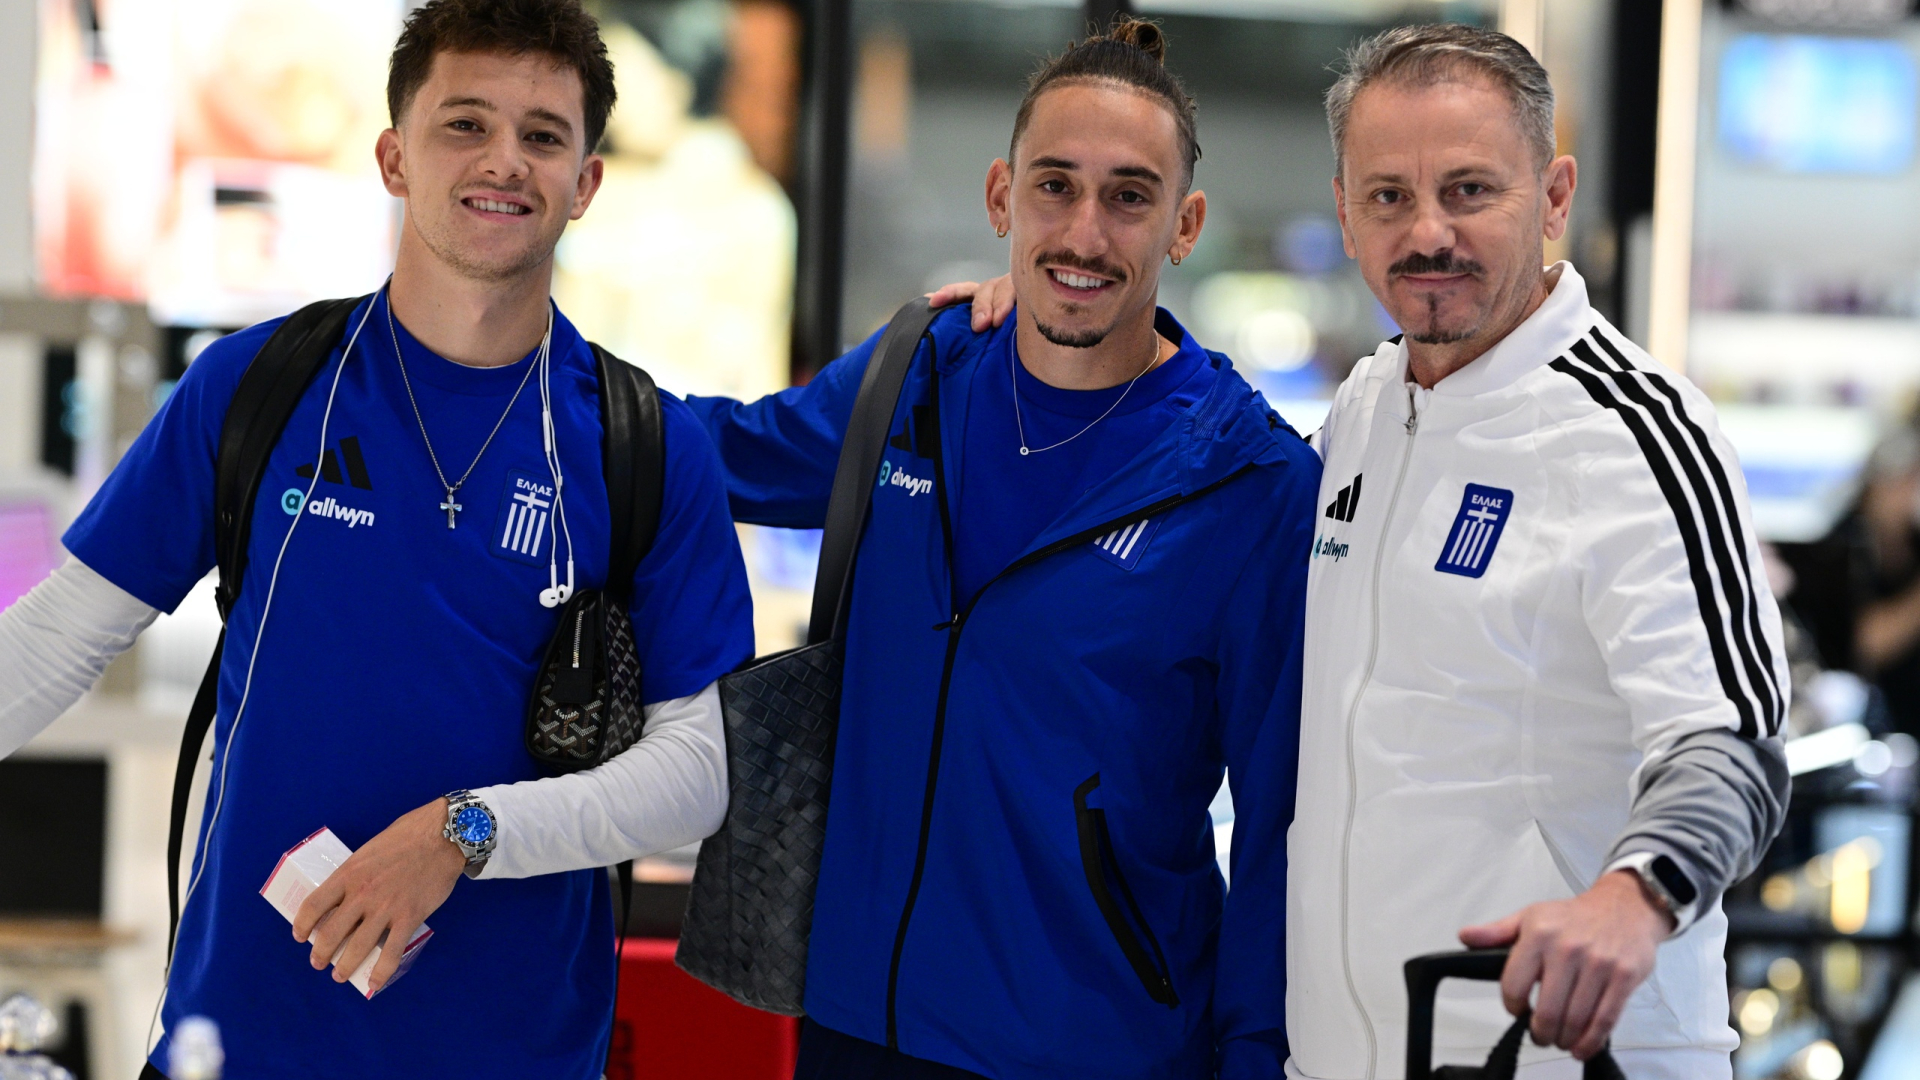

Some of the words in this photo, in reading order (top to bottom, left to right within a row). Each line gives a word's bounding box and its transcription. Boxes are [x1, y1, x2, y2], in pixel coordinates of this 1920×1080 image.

[516, 478, 553, 497] ΕΛΛΑΣ
[891, 466, 933, 497] alwyn
[308, 496, 375, 528] allwyn
[1471, 494, 1504, 509] ΕΛΛΑΣ
[1321, 536, 1350, 563] allwyn
